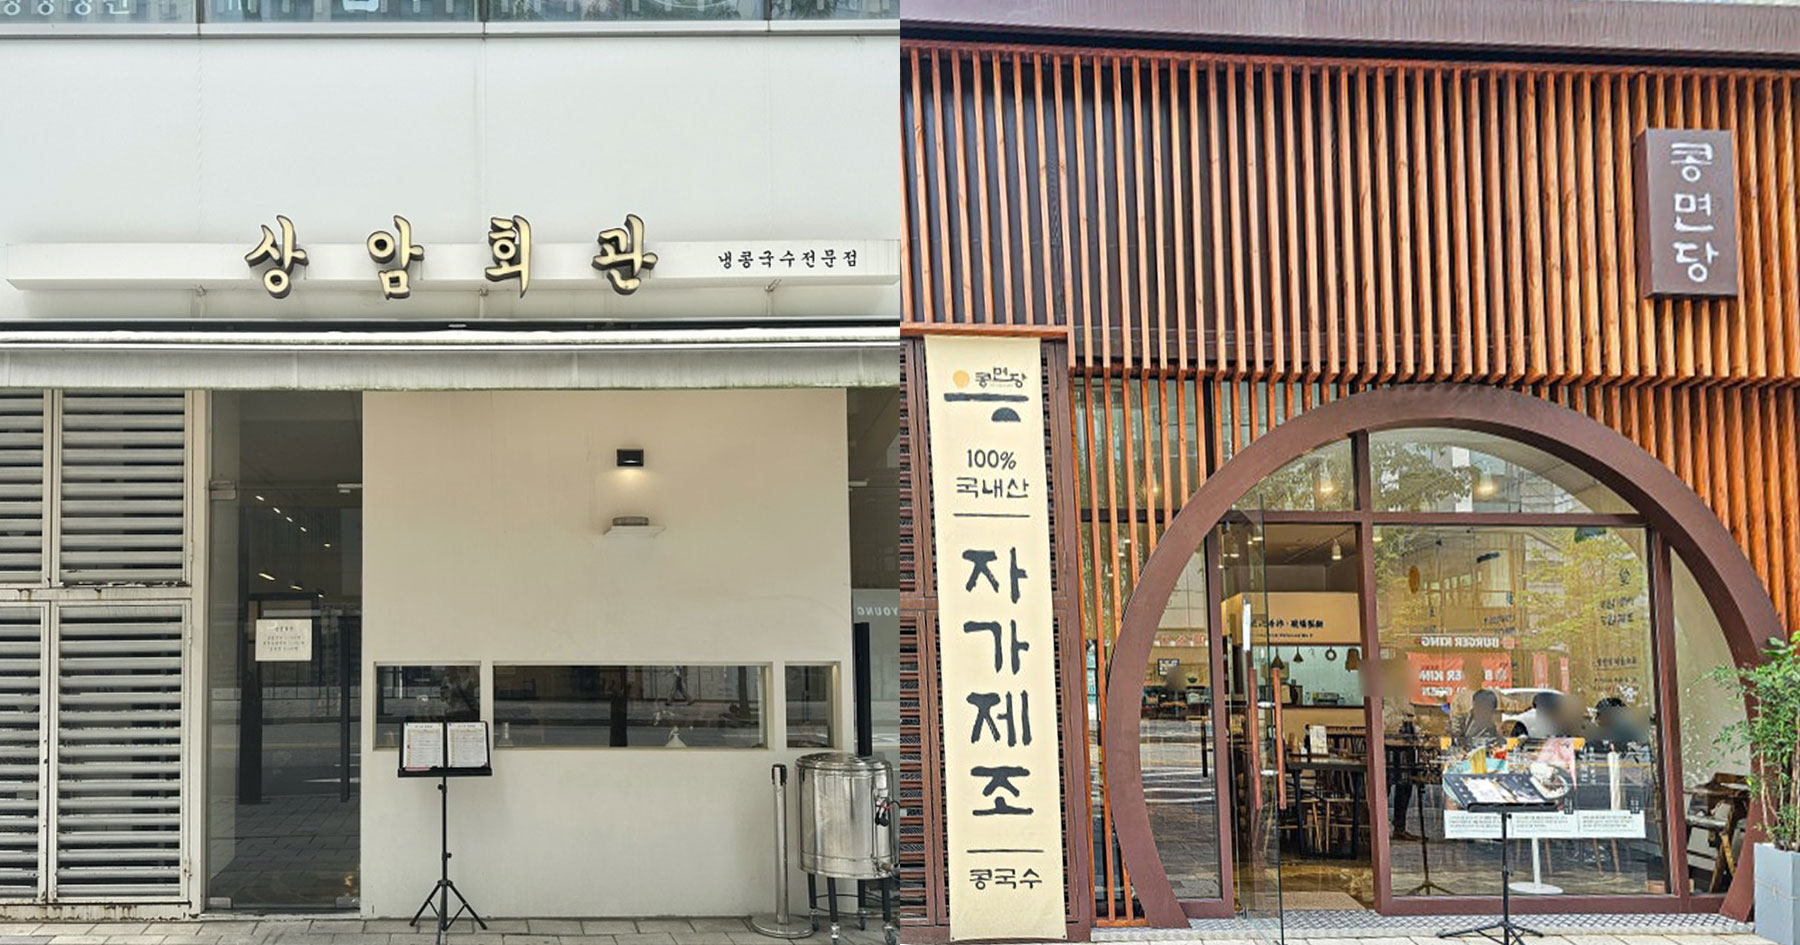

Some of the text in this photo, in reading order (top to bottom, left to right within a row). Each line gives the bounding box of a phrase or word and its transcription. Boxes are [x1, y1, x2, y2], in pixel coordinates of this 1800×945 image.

[1670, 142, 1719, 282] 콩면당
[244, 214, 659, 299] 상암회관
[718, 249, 857, 269] 냉콩국수전문점
[967, 448, 1017, 470] 100%
[956, 477, 1029, 498] 국내산
[962, 547, 1034, 816] 자가제조
[969, 868, 1043, 890] 콩국수
